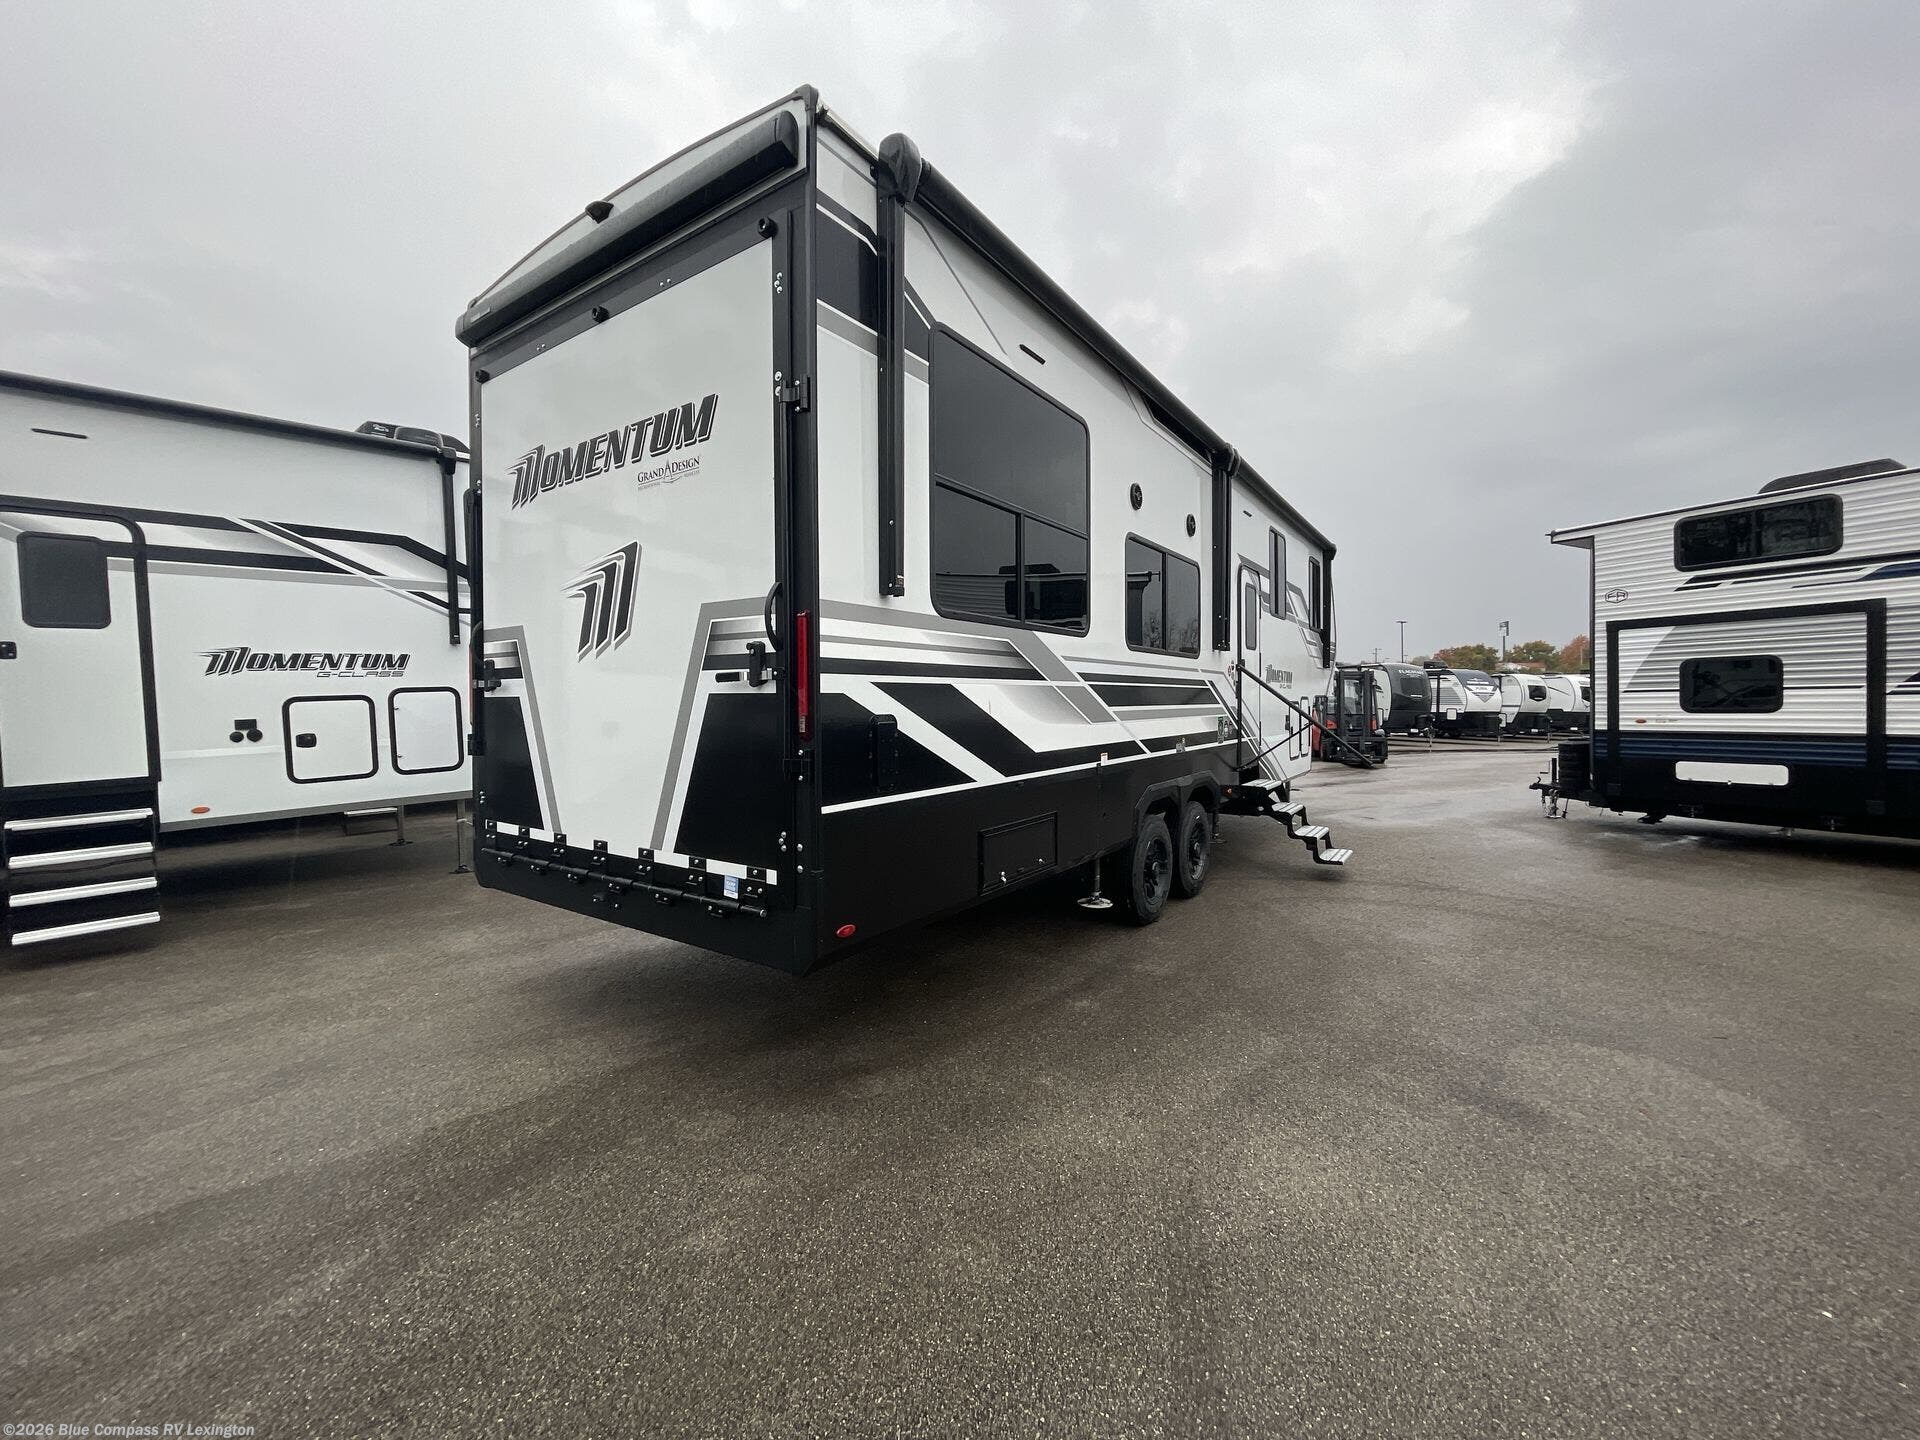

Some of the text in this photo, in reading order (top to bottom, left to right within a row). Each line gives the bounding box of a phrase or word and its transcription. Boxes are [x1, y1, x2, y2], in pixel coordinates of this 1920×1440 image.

[505, 394, 718, 510] MOMENTUM
[638, 456, 700, 482] GRAND DESIGN
[194, 646, 410, 676] MOMENTUM
